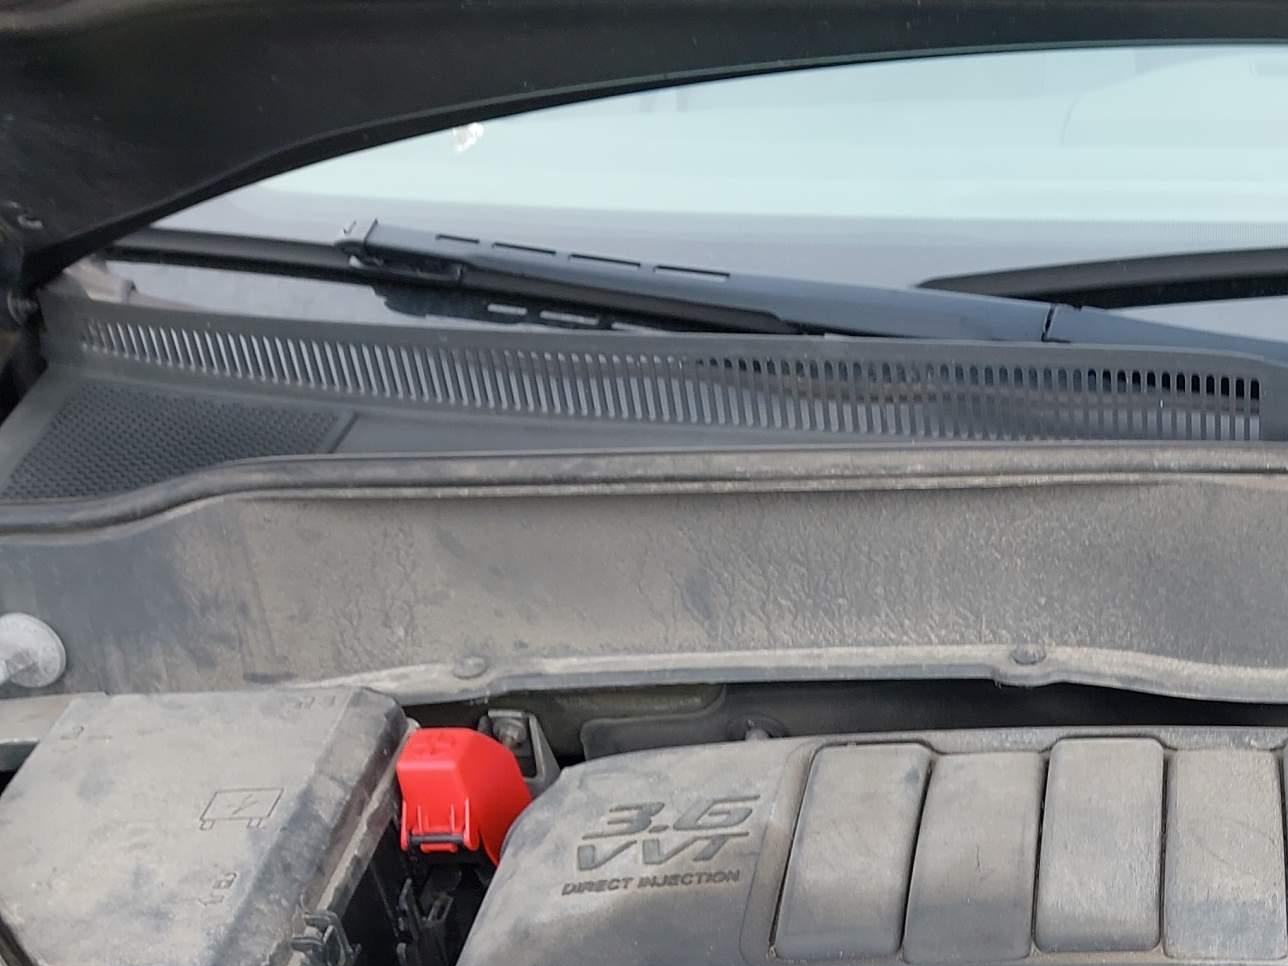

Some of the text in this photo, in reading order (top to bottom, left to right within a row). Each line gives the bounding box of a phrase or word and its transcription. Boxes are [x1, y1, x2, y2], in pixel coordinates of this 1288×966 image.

[582, 795, 760, 840] 3.6
[577, 832, 749, 871] VVT
[562, 869, 740, 896] DIRECT INJECTION
